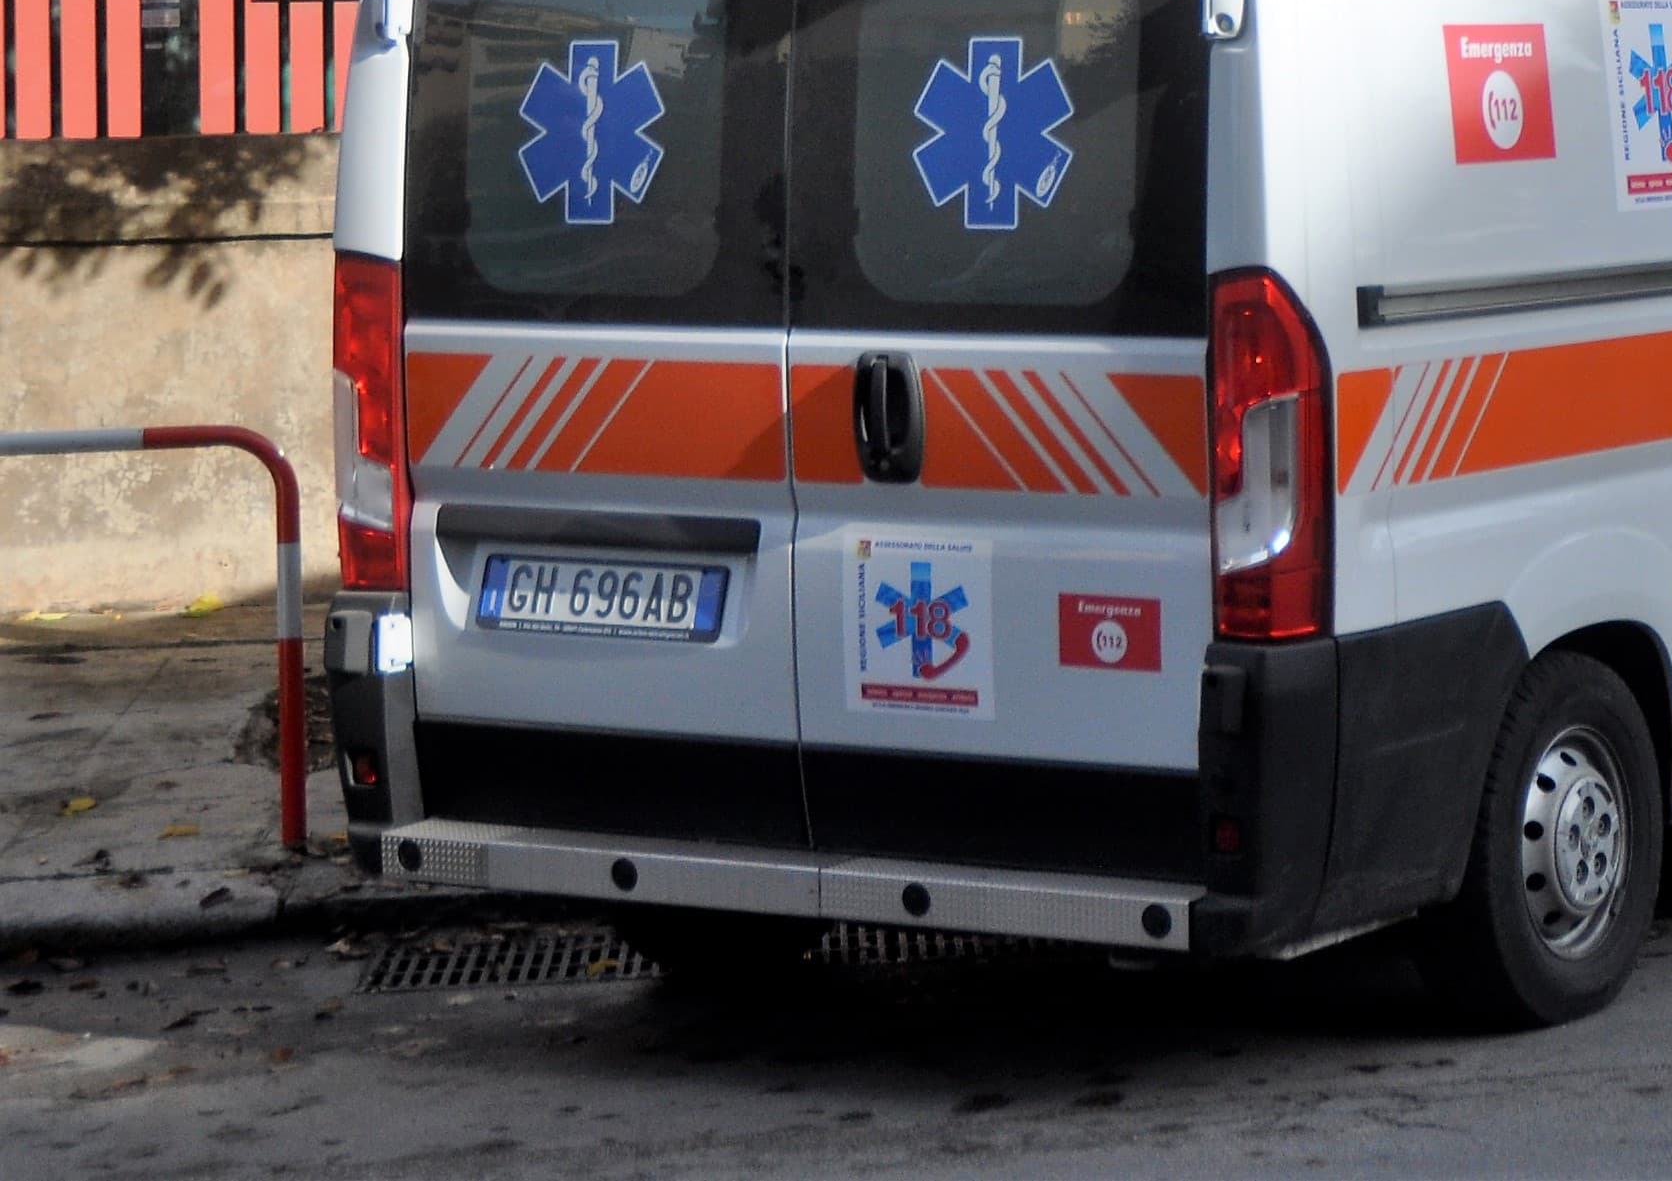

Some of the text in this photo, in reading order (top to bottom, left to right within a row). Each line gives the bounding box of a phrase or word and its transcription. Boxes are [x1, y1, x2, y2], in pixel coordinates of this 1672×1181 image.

[1460, 36, 1533, 63] Emergenza
[508, 564, 694, 623] GH 696AB
[1078, 600, 1143, 618] Emergenza
[889, 599, 952, 641] 118
